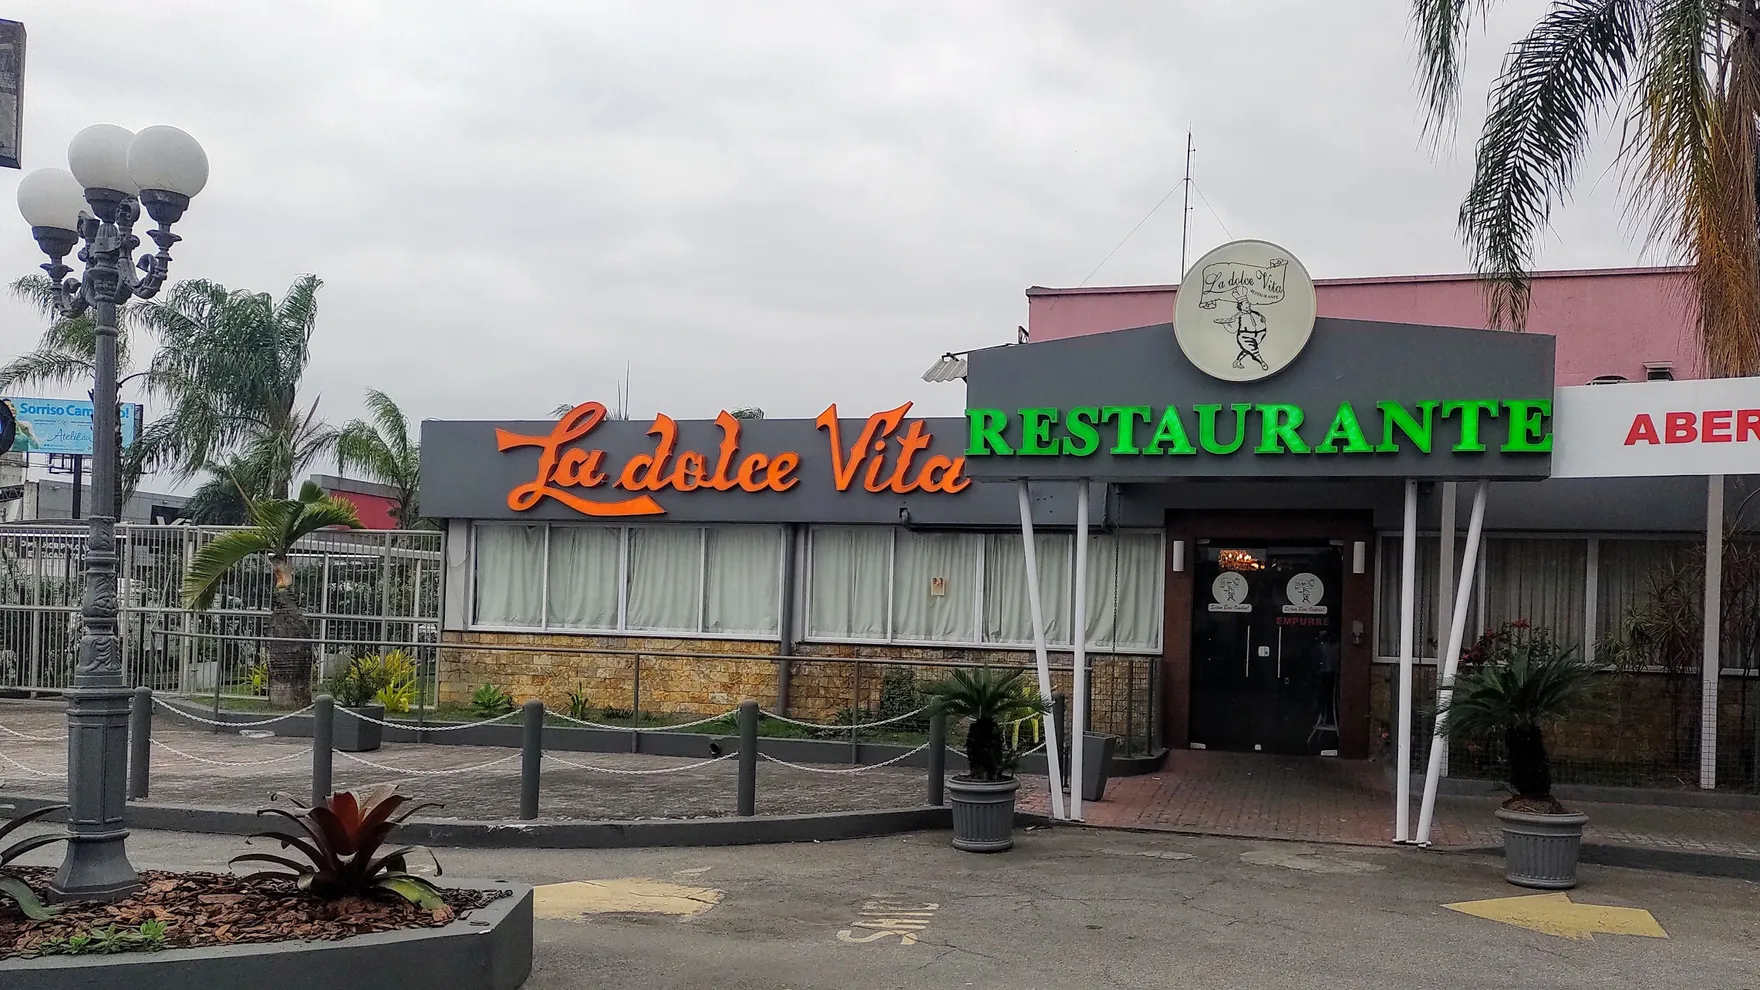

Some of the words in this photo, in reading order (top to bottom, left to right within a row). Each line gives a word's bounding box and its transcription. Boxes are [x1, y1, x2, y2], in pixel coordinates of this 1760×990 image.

[1204, 272, 1231, 295] La
[1228, 270, 1255, 287] dolce
[1256, 270, 1284, 293] Vita
[20, 403, 64, 417] Sorriso
[963, 399, 1554, 457] RESTAURANTE
[495, 400, 668, 517] La
[612, 408, 802, 493] dolce
[815, 400, 974, 495] Vita
[1276, 617, 1330, 626] EMPURRE
